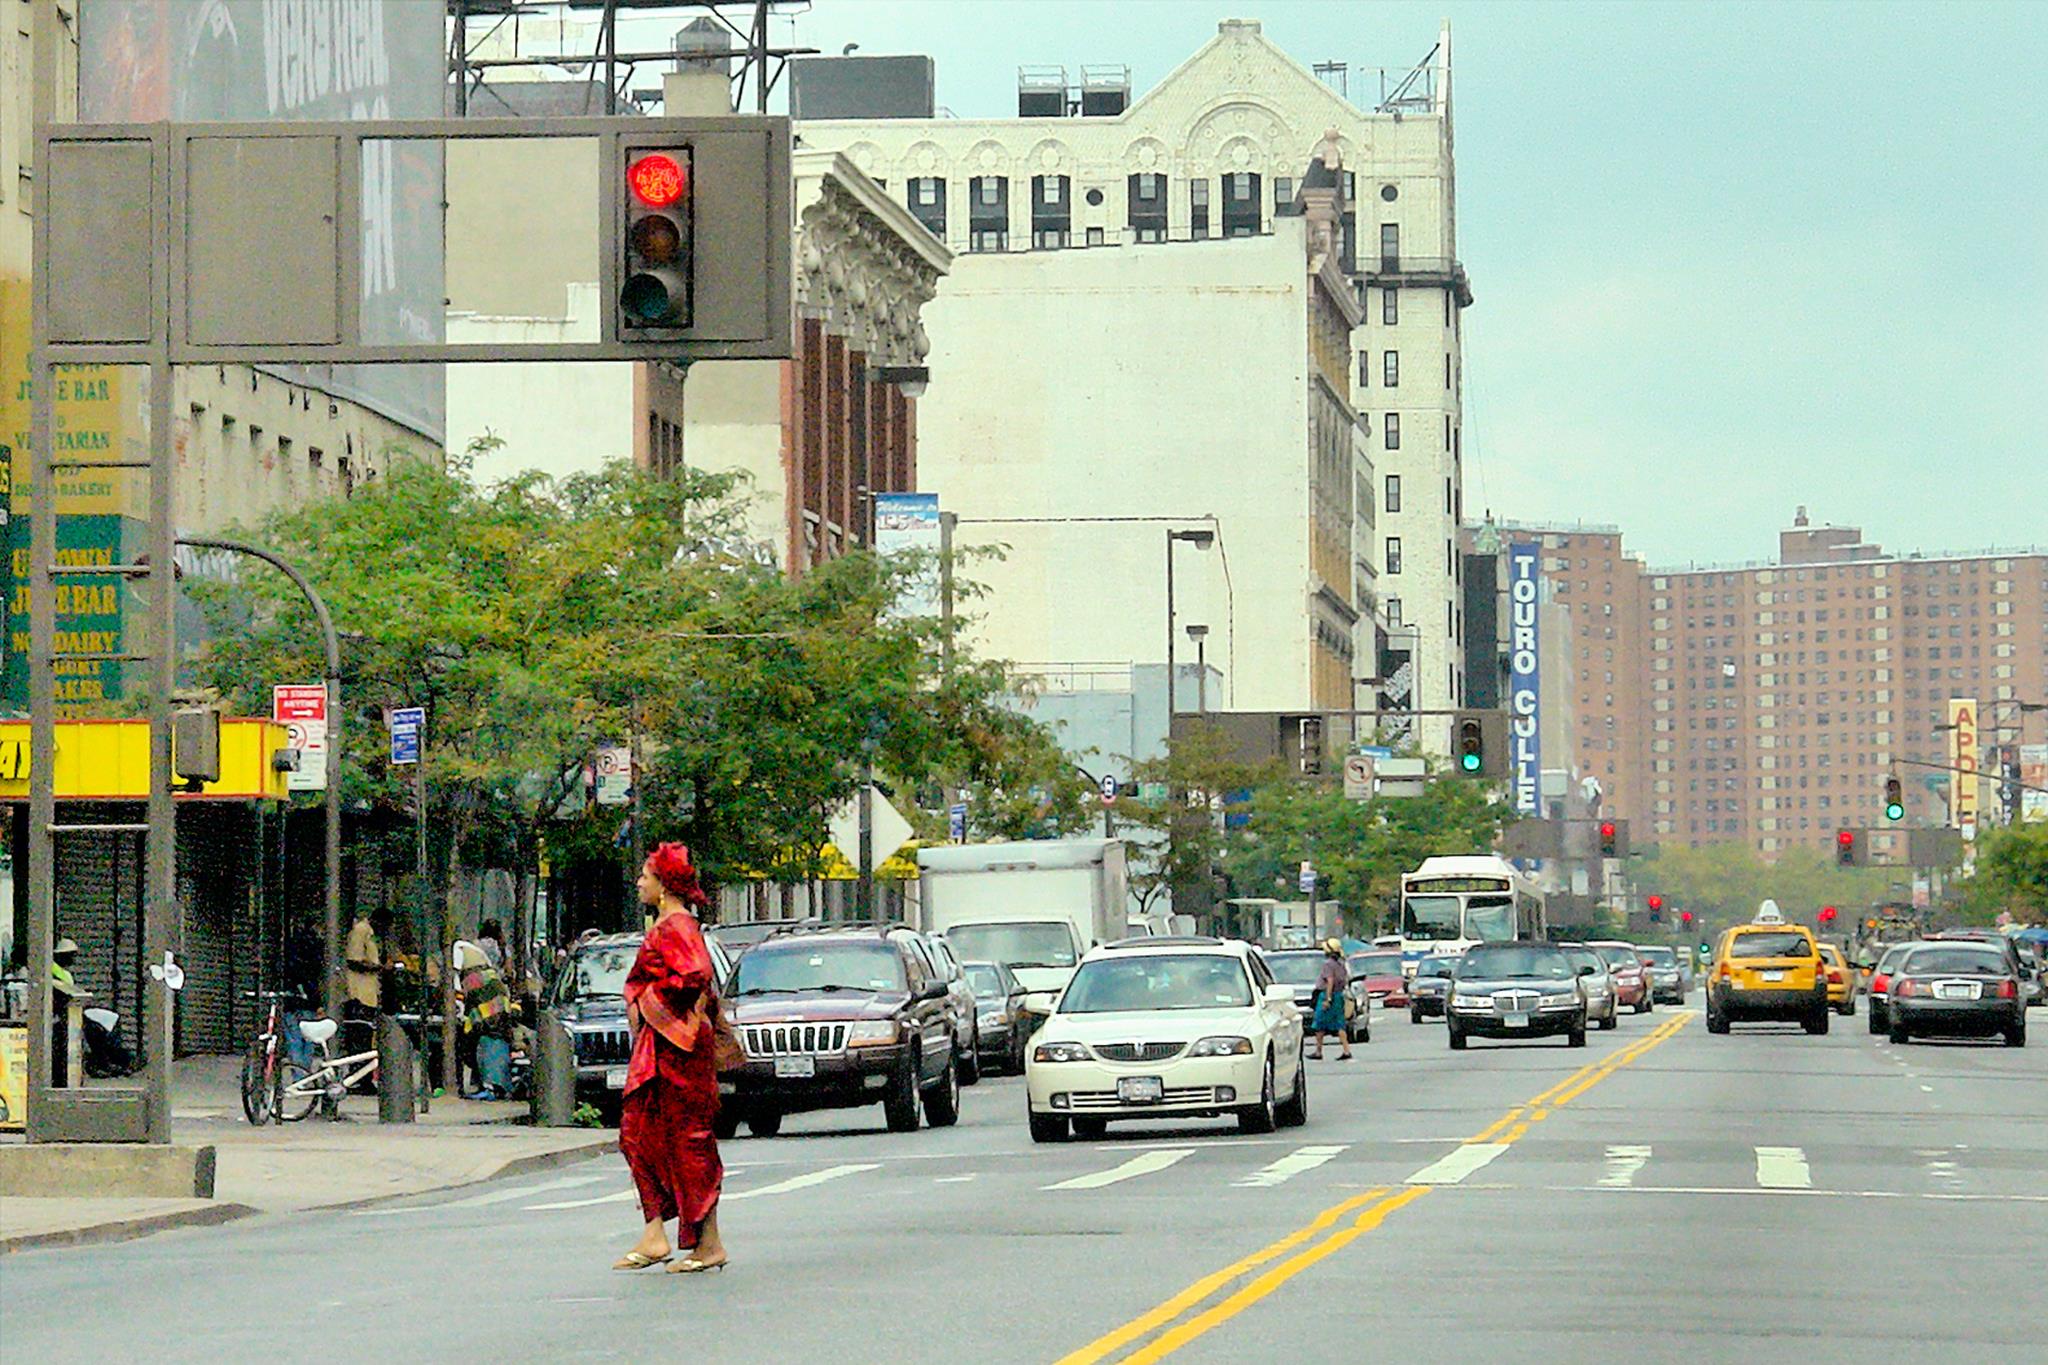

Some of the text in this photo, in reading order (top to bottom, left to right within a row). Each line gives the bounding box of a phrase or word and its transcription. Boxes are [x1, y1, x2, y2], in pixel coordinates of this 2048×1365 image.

[74, 379, 109, 400] BAR
[72, 585, 118, 614] BAR
[1513, 555, 1536, 674] TOURO
[52, 631, 117, 653] DAIRY
